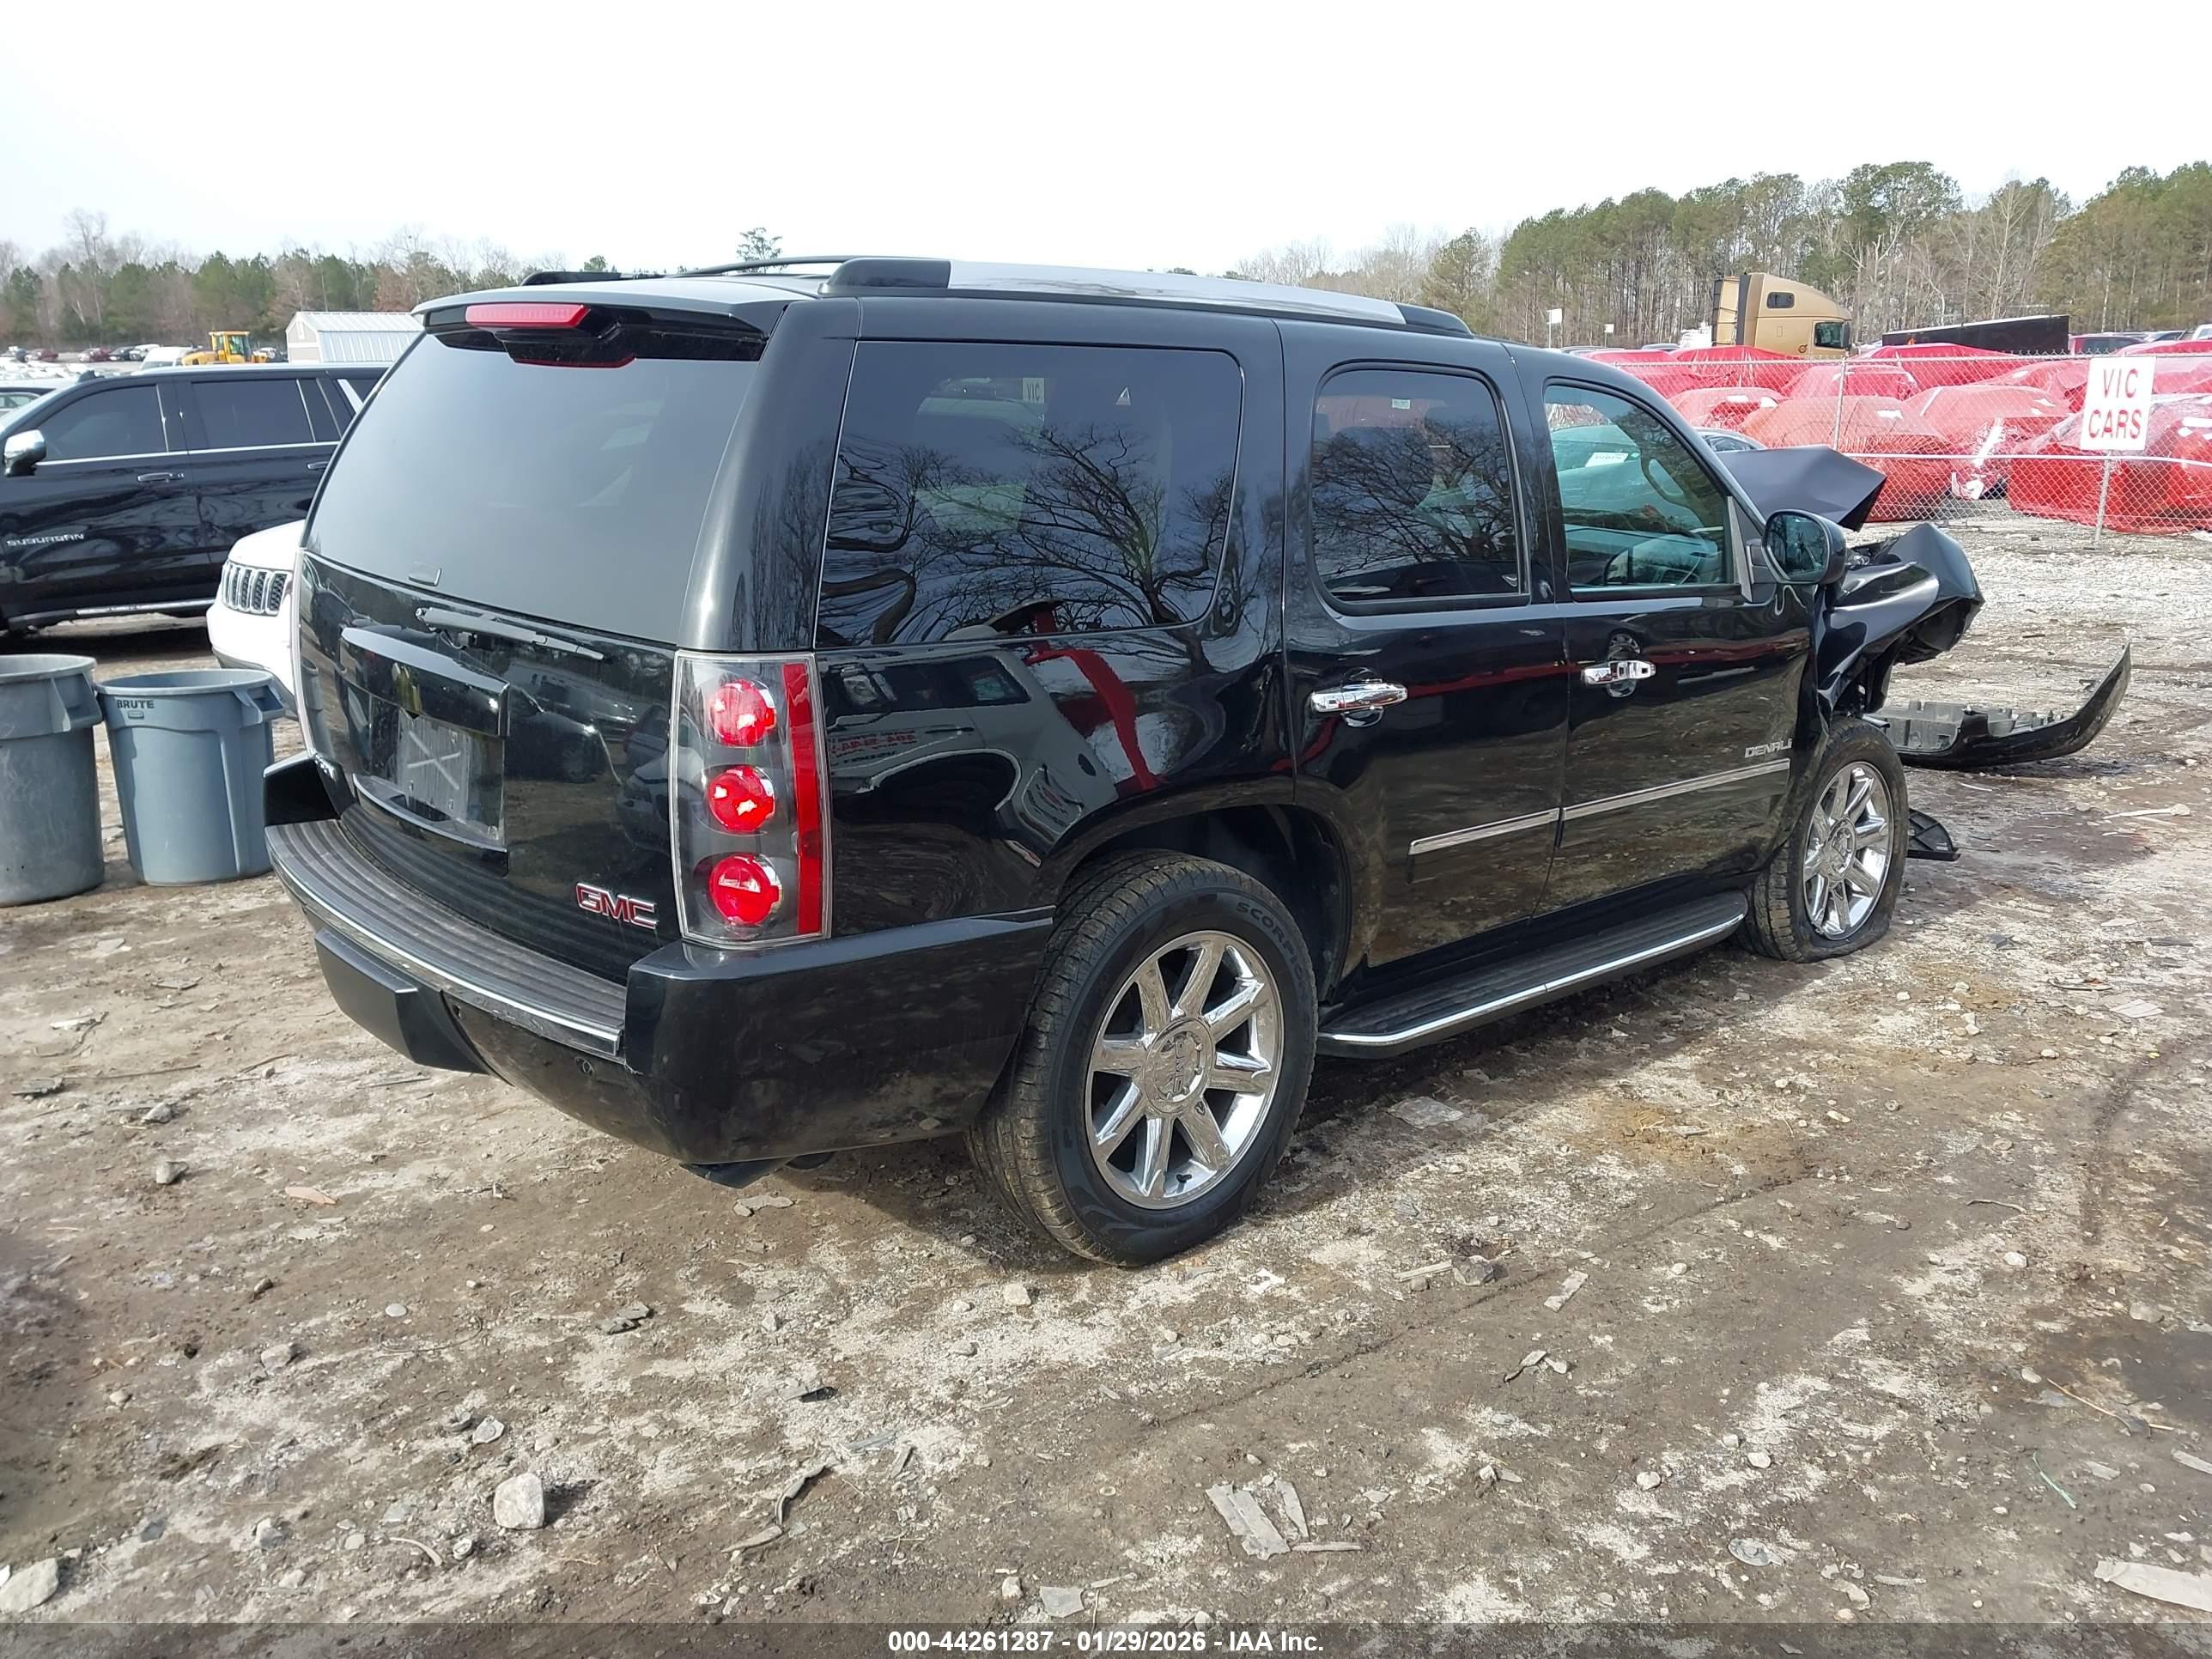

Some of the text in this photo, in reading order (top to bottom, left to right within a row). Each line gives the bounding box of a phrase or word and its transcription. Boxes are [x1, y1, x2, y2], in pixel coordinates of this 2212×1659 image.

[2103, 368, 2139, 398] VIC
[2088, 410, 2142, 439] CARS
[6, 533, 84, 546] SUBURBAN
[117, 700, 155, 708] BRUTE
[1745, 738, 1792, 758] DENALI
[576, 883, 657, 929] GMC
